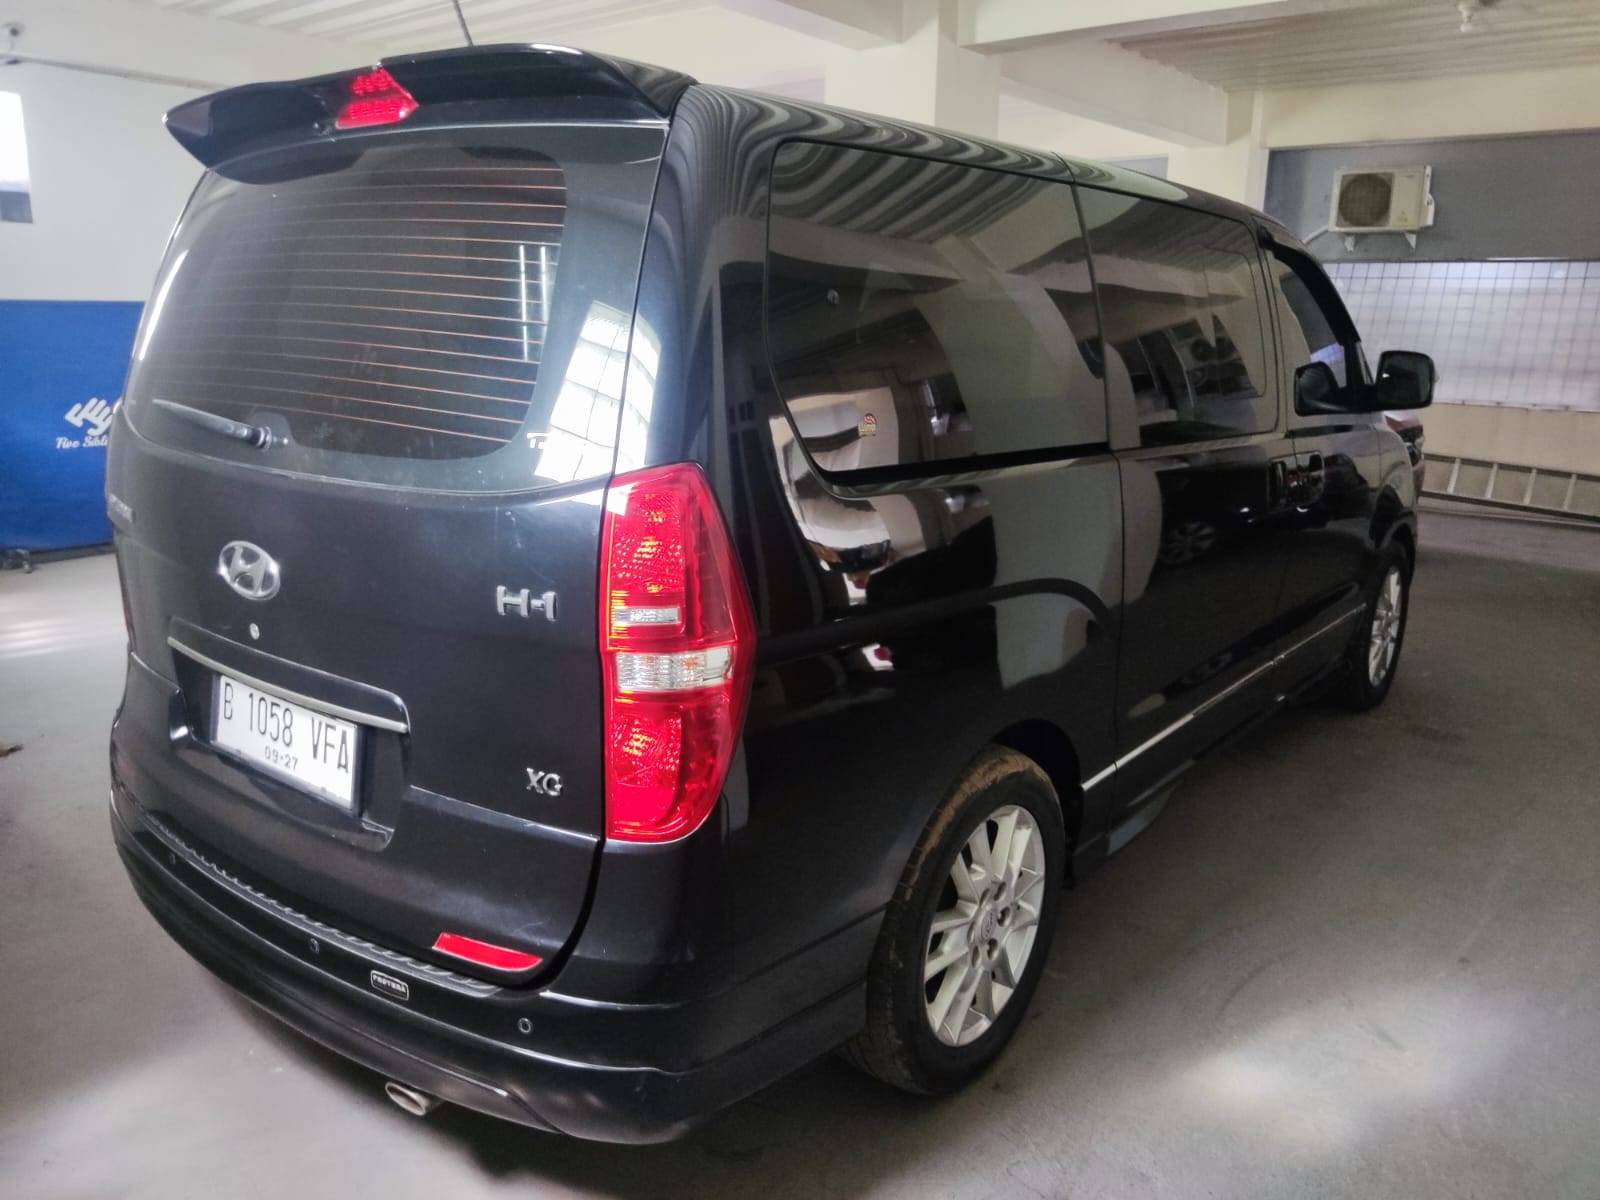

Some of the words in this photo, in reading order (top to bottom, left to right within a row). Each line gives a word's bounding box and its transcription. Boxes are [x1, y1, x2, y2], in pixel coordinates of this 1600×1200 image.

[496, 584, 558, 622] H-1
[223, 683, 234, 720] B
[248, 692, 294, 747] 1058
[311, 717, 350, 773] VFA
[526, 767, 563, 797] XG
